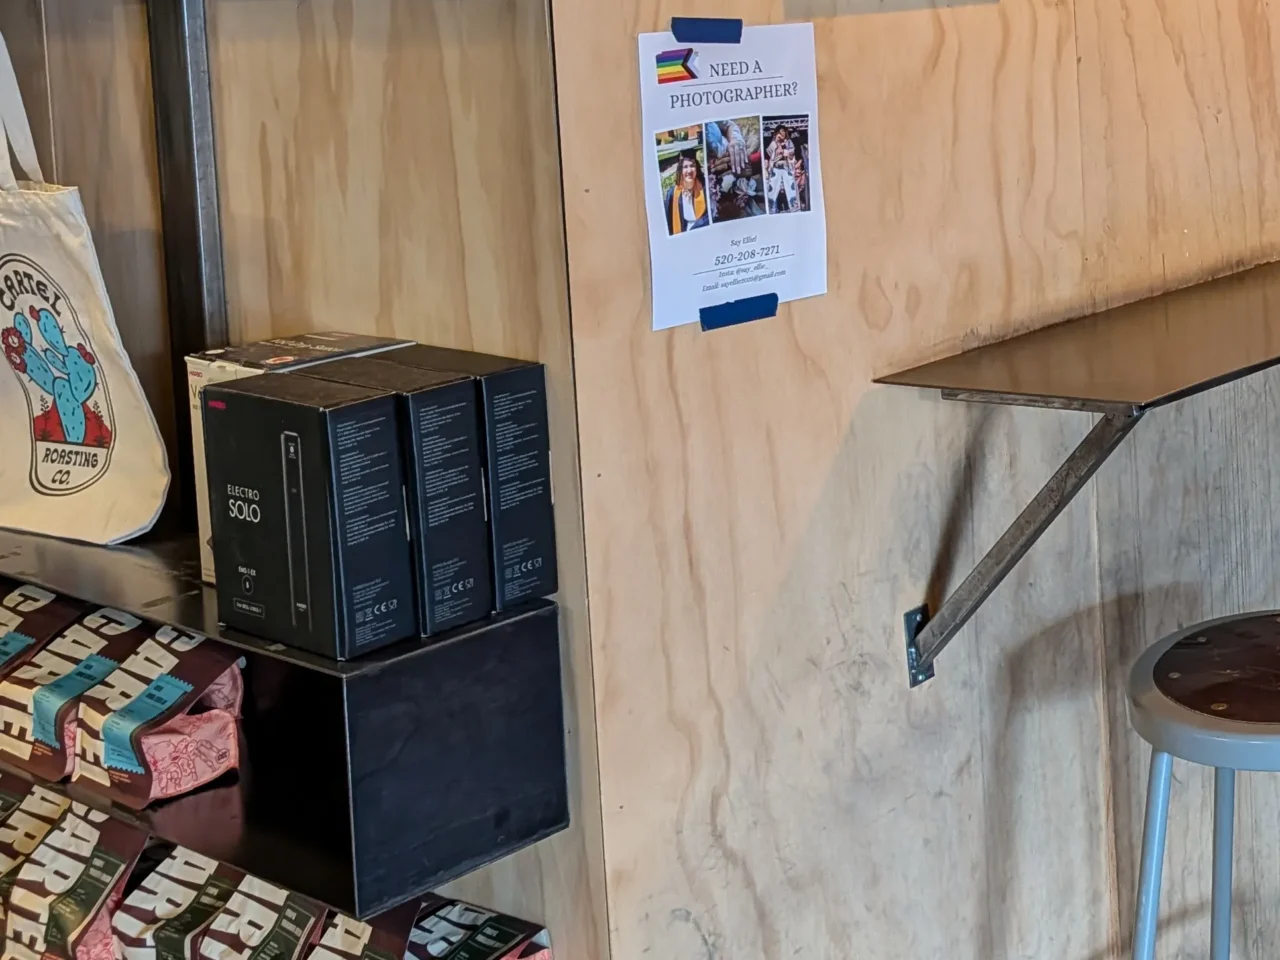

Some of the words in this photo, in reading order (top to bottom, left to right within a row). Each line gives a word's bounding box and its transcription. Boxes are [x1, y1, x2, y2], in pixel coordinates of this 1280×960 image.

[709, 60, 749, 78] NEED
[753, 60, 763, 73] A
[670, 81, 798, 109] PHOTOGRAPHER?
[730, 239, 741, 247] Say
[714, 245, 780, 266] 520-208-7271
[0, 270, 61, 317] CARTEL
[42, 447, 98, 468] ROASTING
[51, 469, 71, 485] CO.
[227, 484, 260, 501] ELECTRO
[229, 498, 261, 523] SOLO
[71, 625, 206, 787] CARTEL
